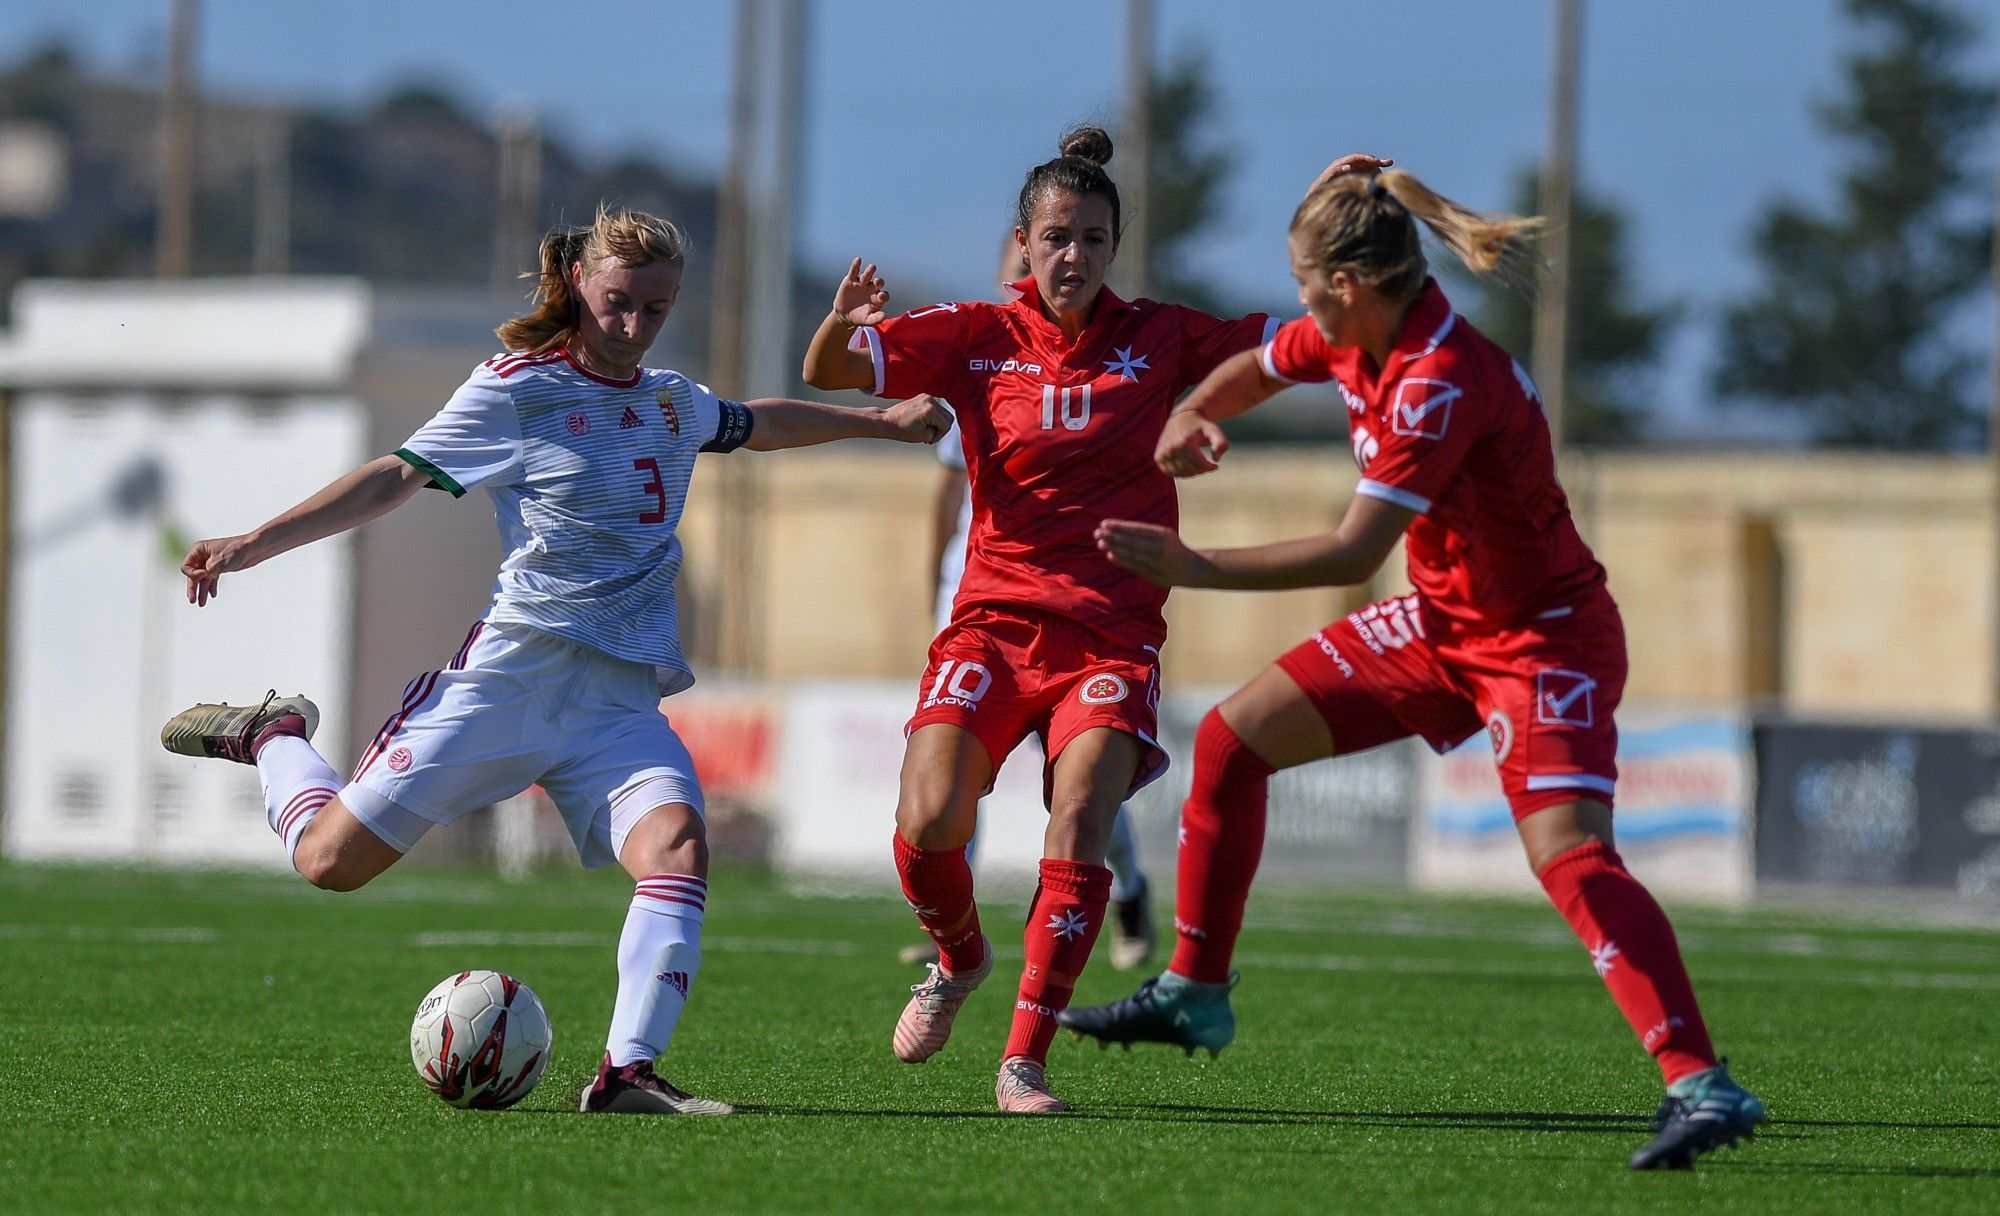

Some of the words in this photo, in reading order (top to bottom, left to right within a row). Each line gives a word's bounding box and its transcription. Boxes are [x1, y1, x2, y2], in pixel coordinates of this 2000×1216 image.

[969, 359, 1043, 375] GIVOVA
[1041, 383, 1092, 430] 10
[633, 456, 667, 524] 3
[927, 659, 992, 701] 10
[922, 696, 977, 712] GIVOVA
